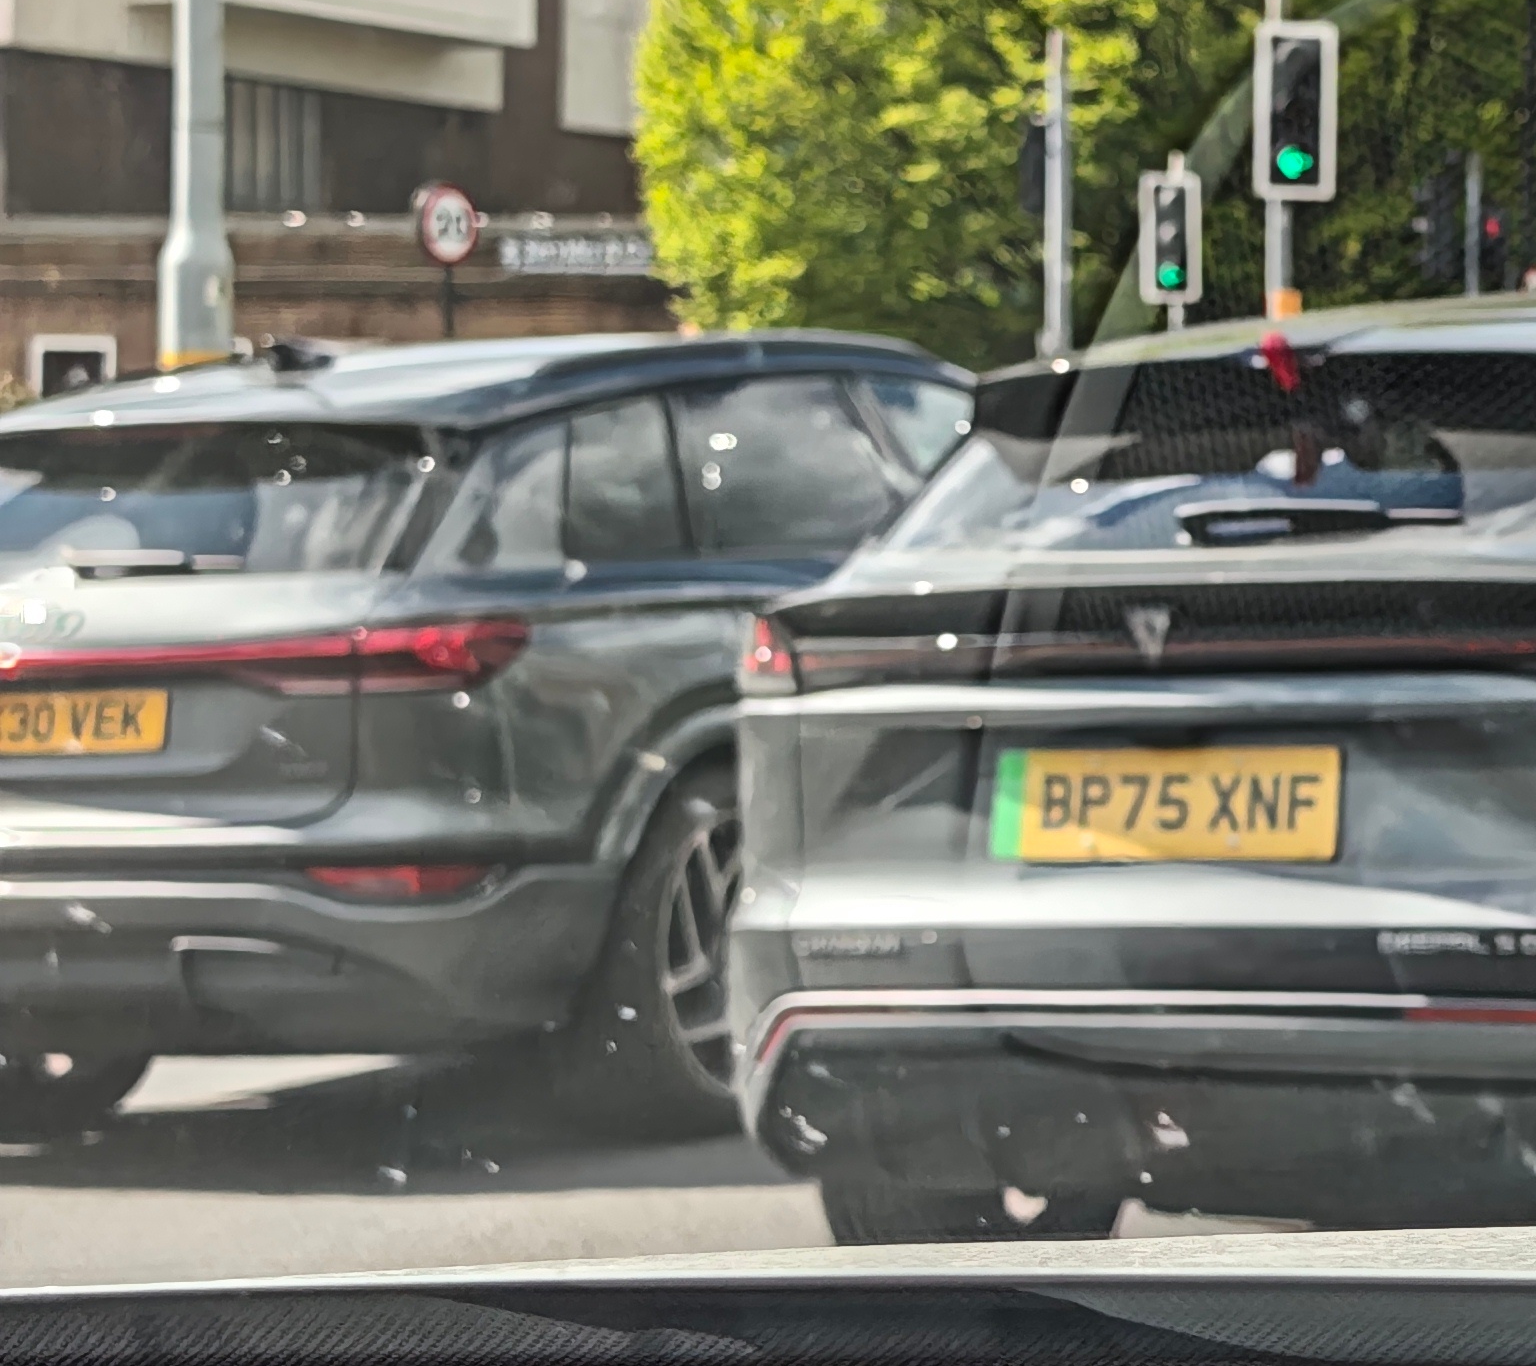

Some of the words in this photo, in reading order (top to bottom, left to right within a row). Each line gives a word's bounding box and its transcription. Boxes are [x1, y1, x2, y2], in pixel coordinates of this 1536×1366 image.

[0, 702, 56, 743] 30
[70, 697, 147, 741] VEK
[1041, 773, 1189, 833] BP75
[1209, 771, 1323, 833] XNF
